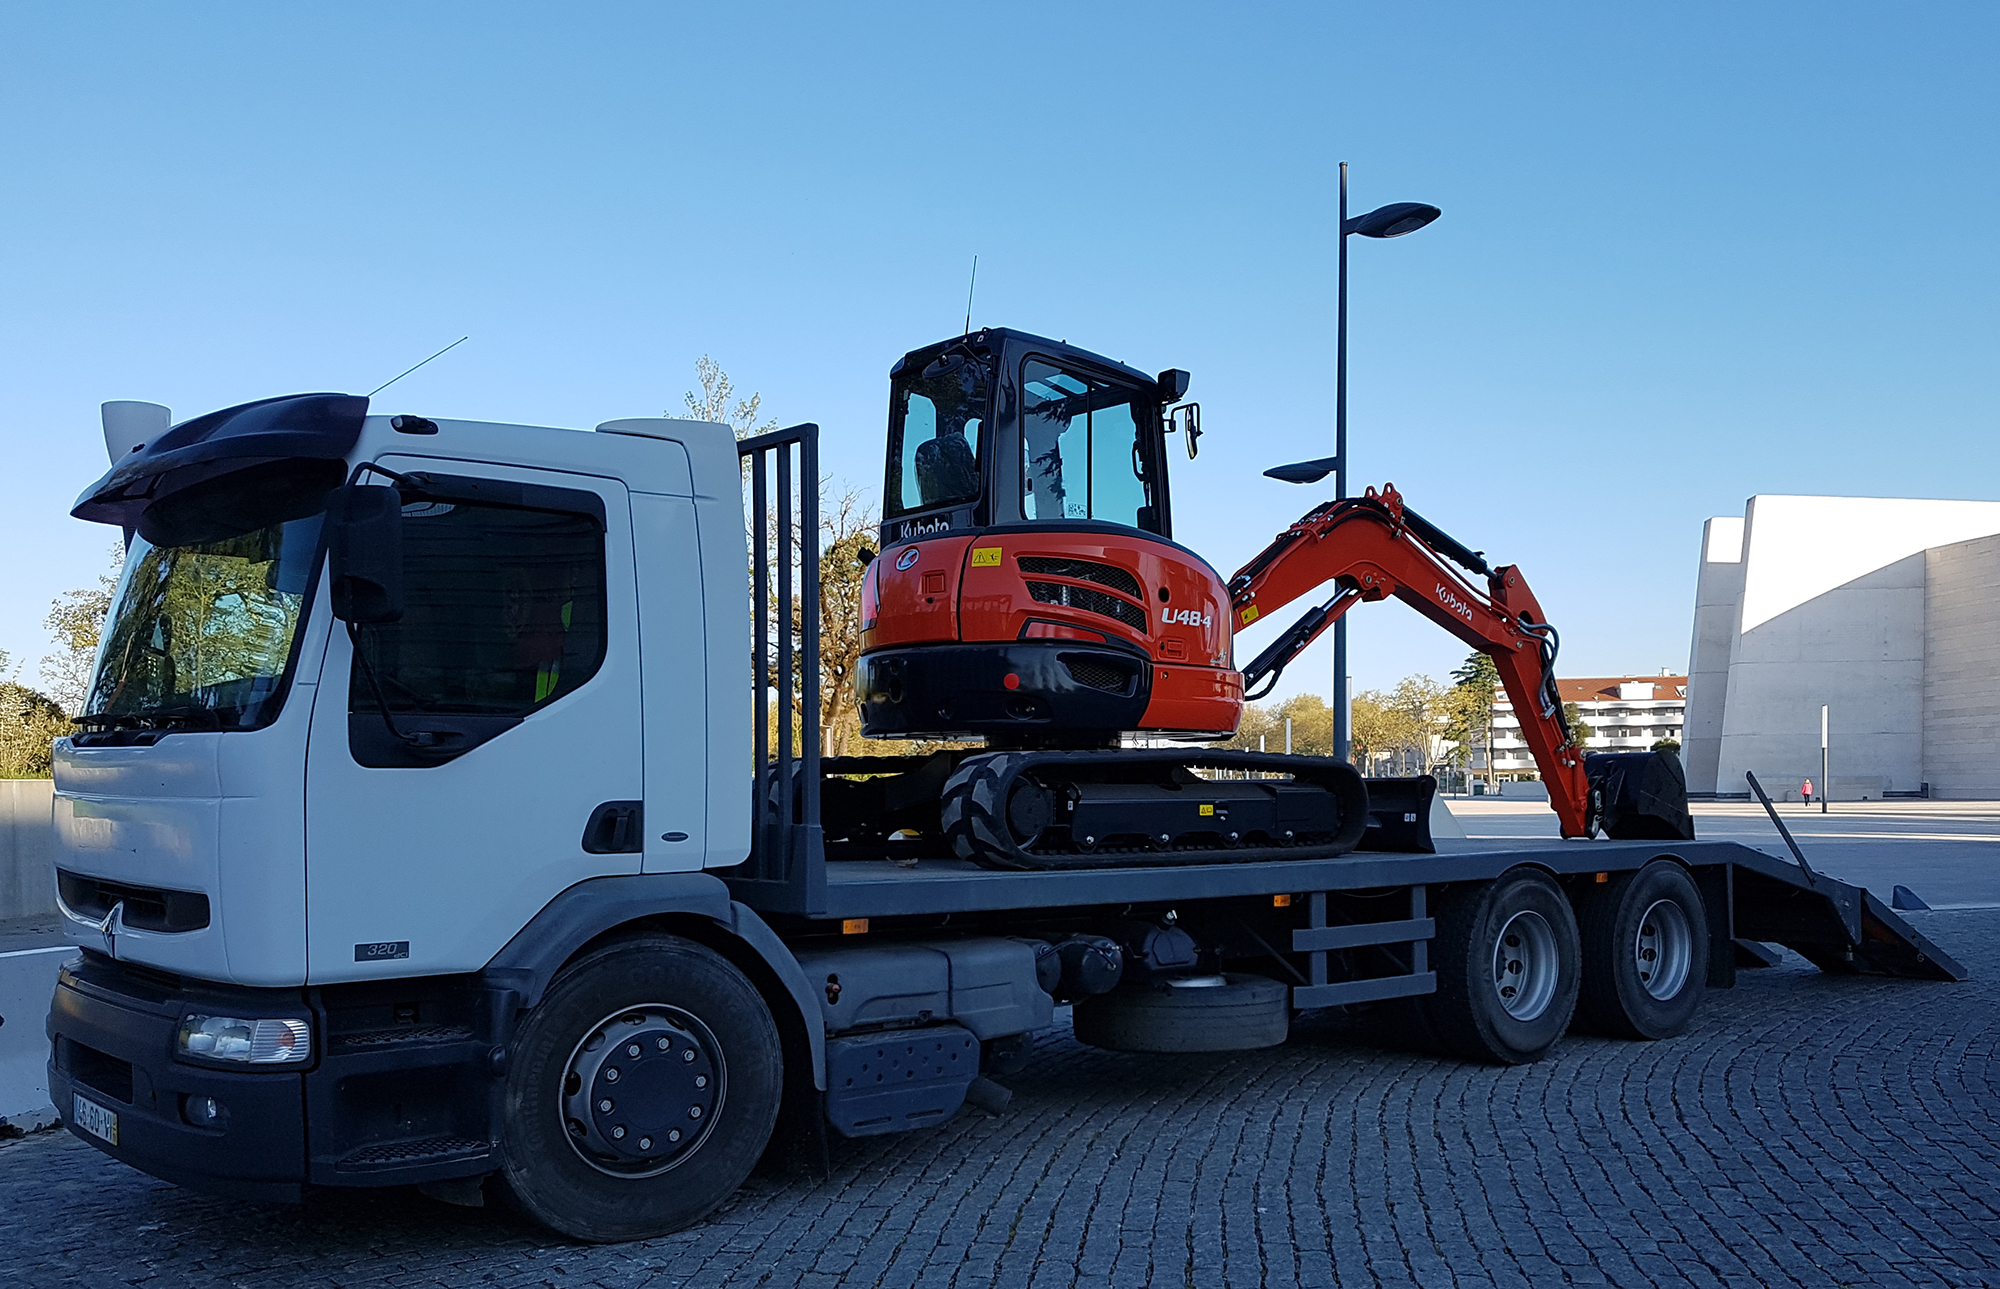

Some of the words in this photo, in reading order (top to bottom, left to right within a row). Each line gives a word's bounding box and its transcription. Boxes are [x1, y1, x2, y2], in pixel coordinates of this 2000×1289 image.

[901, 518, 949, 538] Kubota
[1435, 582, 1473, 621] Kubota
[367, 943, 398, 956] 320
